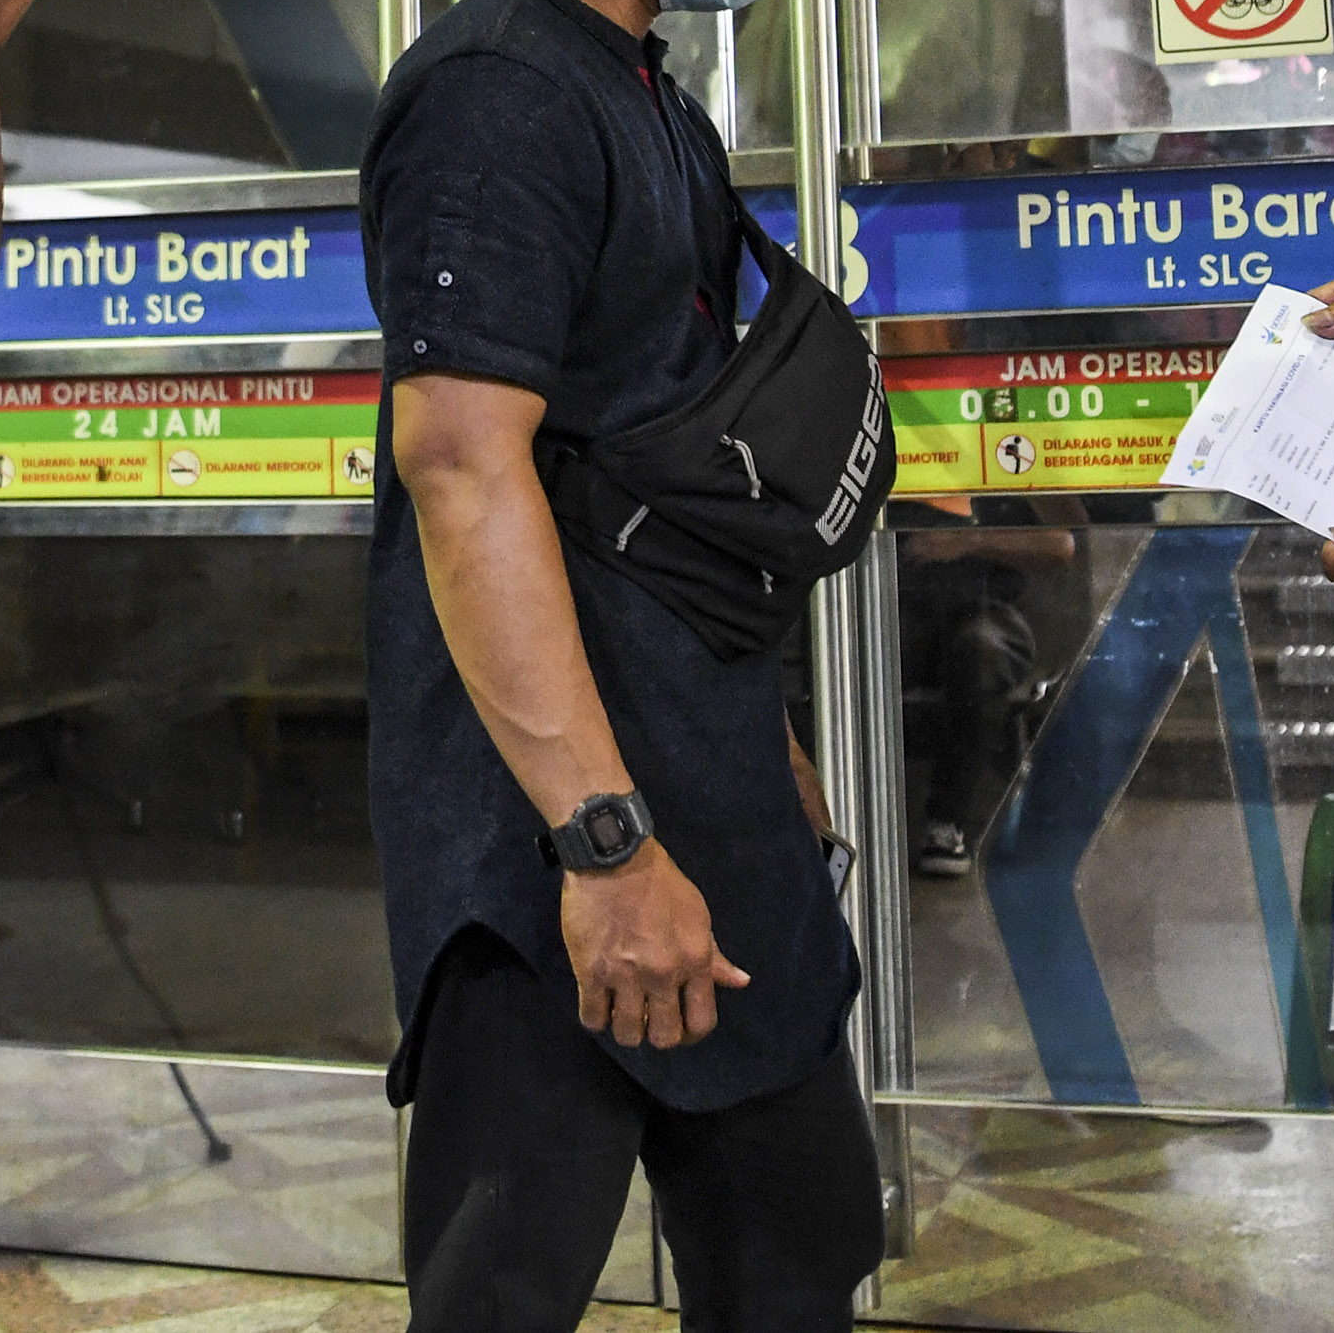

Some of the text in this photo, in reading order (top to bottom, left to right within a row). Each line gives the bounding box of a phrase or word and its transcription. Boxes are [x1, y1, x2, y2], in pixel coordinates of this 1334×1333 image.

[1017, 190, 1183, 249] Pintu
[5, 226, 311, 288] Pintu Barat
[1146, 251, 1273, 290] Lt. SLG
[104, 293, 205, 326] Lt. SLG
[1000, 355, 1066, 381] JAM
[53, 380, 229, 406] OPERASIONAL
[242, 378, 315, 402] PINTU
[143, 409, 222, 439] JAM
[1043, 437, 1112, 451] DILARANG
[1118, 435, 1164, 449] MASUK
[21, 457, 75, 468] DILARANG
[80, 456, 118, 467] MASUK
[206, 461, 324, 473] DILARANG MEROKOK
[1044, 453, 1133, 467] BERSERAGAM
